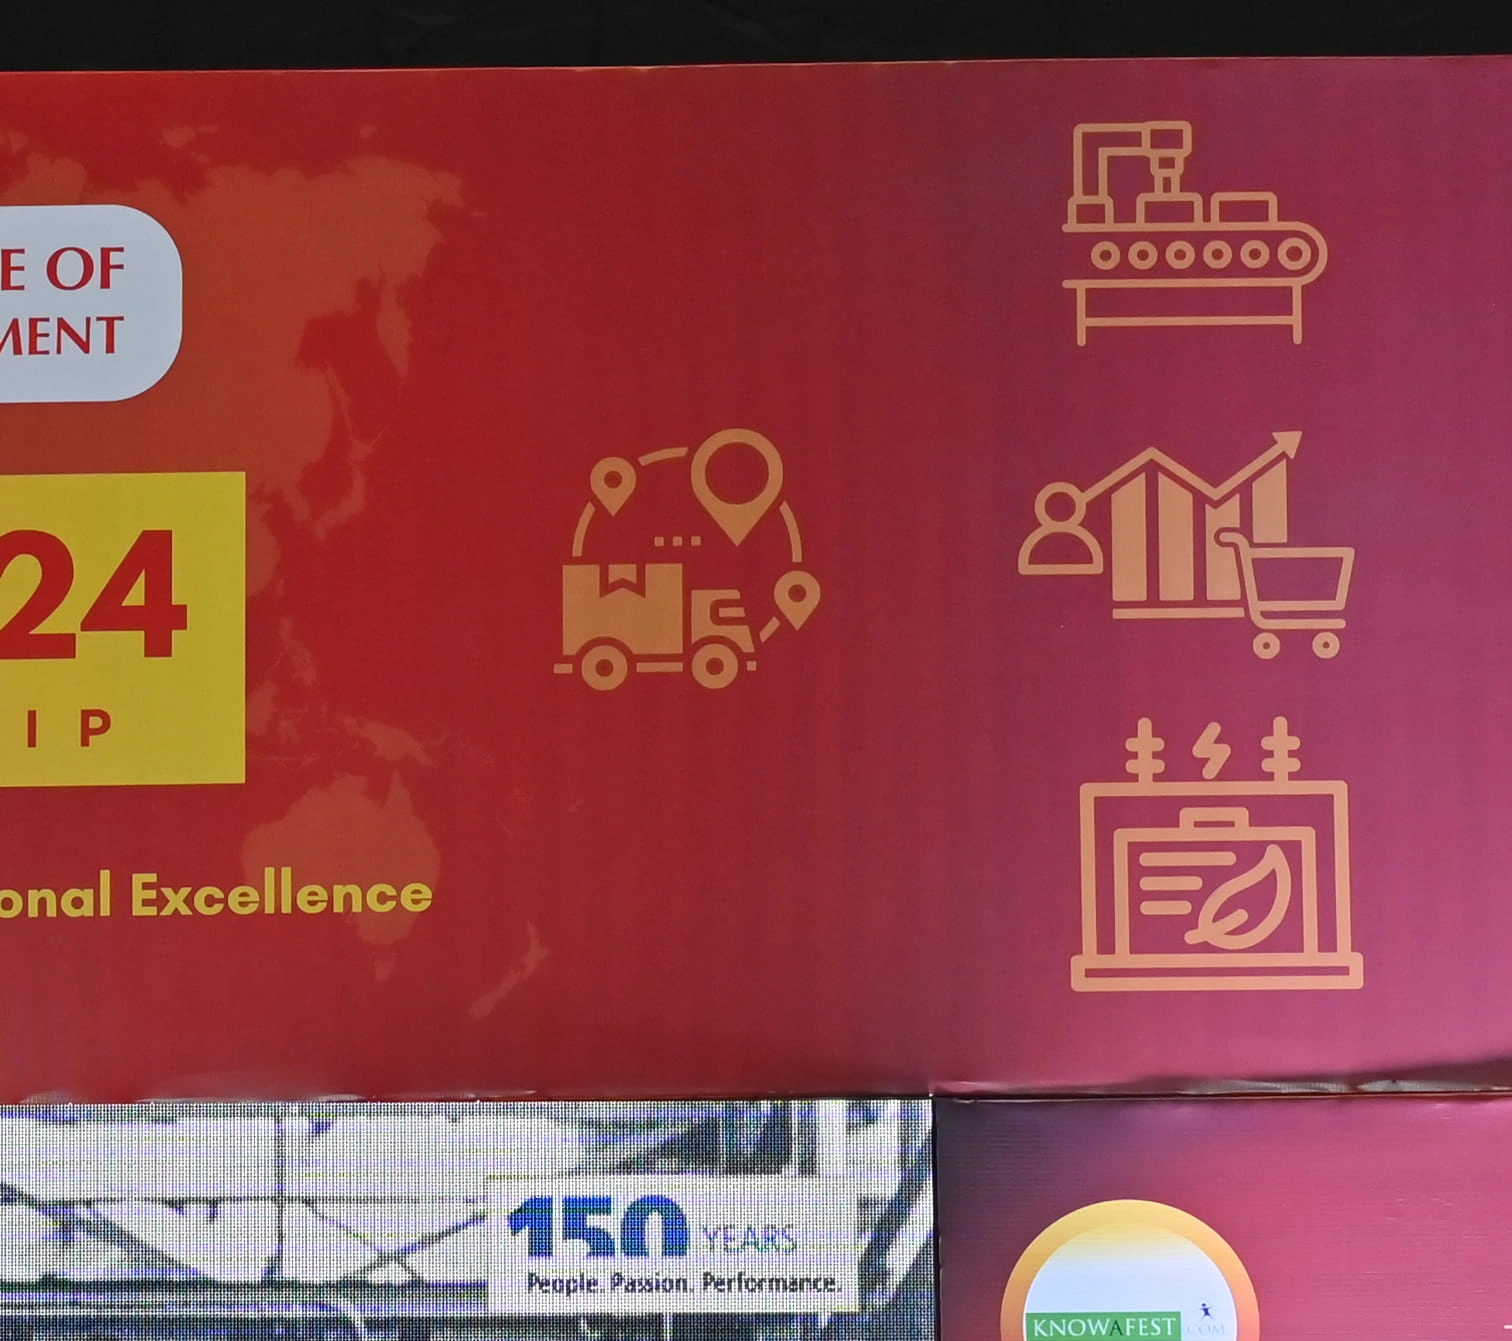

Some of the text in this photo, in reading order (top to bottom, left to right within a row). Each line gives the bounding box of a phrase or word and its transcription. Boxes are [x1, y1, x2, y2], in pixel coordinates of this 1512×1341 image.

[47, 247, 124, 290] OF
[132, 867, 432, 916] Excellence
[507, 1195, 798, 1258] 150 YEARS
[528, 1272, 843, 1296] People. Passion. Performance.
[1033, 1318, 1176, 1337] KNOWAFEST
